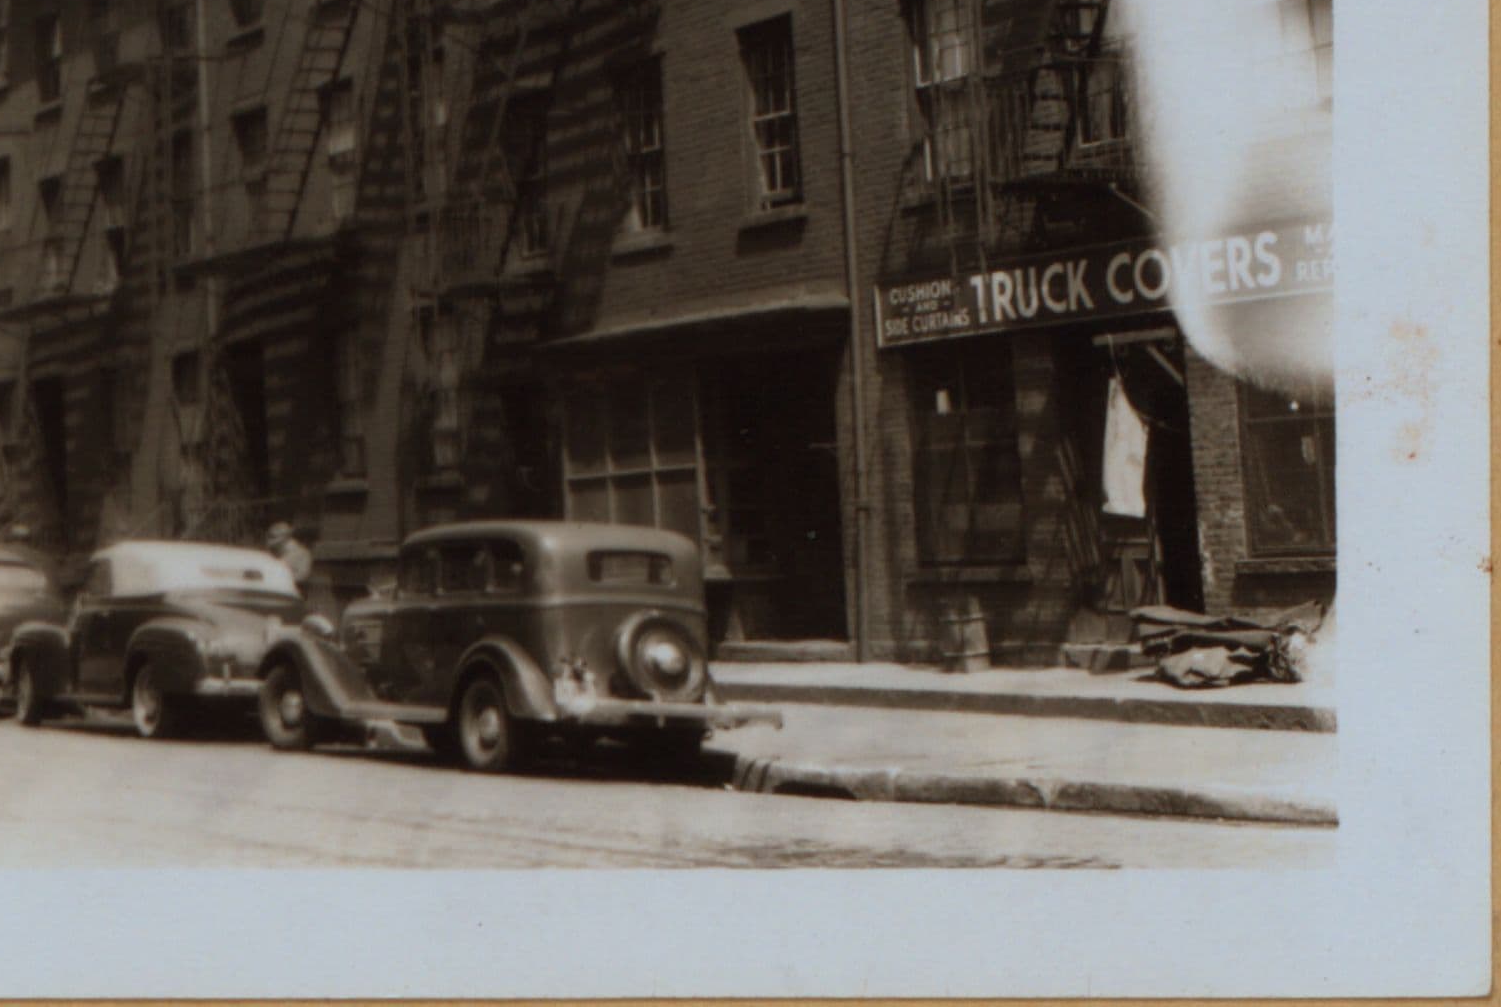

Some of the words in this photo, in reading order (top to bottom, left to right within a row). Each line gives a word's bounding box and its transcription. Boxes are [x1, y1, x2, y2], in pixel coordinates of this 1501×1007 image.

[970, 259, 1094, 324] TRUCK
[1105, 231, 1282, 305] COVERS
[890, 279, 952, 305] CUSHION
[915, 300, 939, 313] AND
[885, 318, 909, 337] SIDE
[912, 307, 971, 333] CURTAINS
